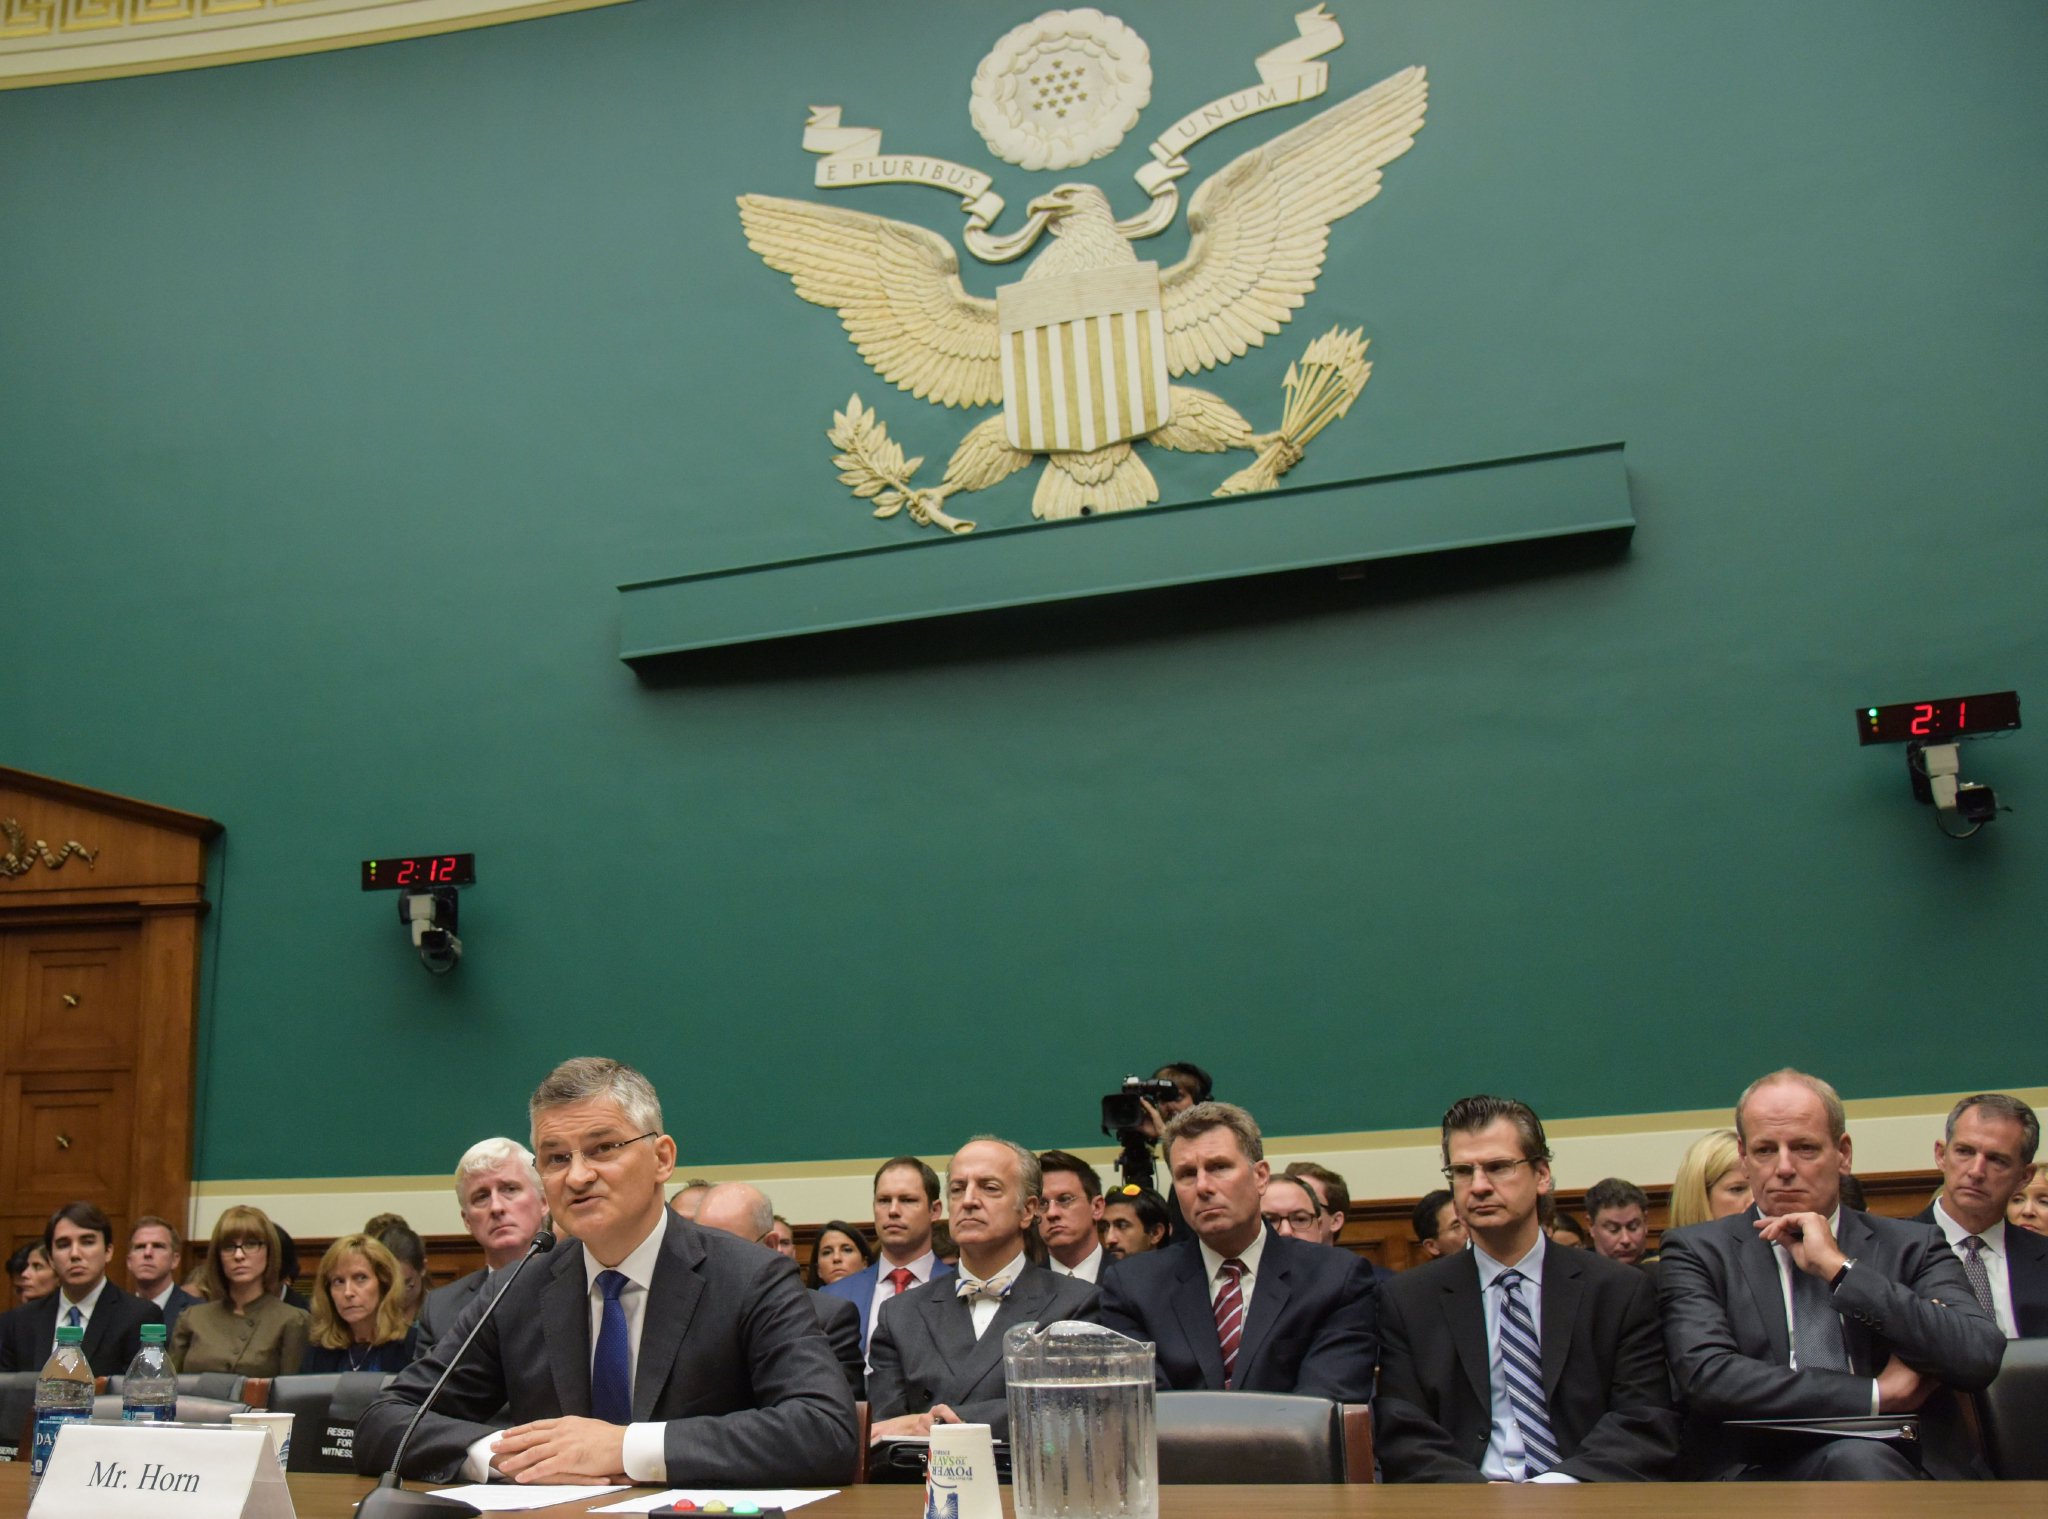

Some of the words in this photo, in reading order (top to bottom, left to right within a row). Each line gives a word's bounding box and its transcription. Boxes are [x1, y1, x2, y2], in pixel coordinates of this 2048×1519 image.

[1177, 87, 1277, 138] UNUM
[826, 164, 837, 181] E
[852, 160, 979, 190] PLURIBUS
[397, 856, 457, 884] 2:12
[336, 1438, 353, 1447] FOR
[86, 1461, 127, 1489] Mr.
[136, 1463, 200, 1493] Horn
[932, 1466, 972, 1477] POWER
